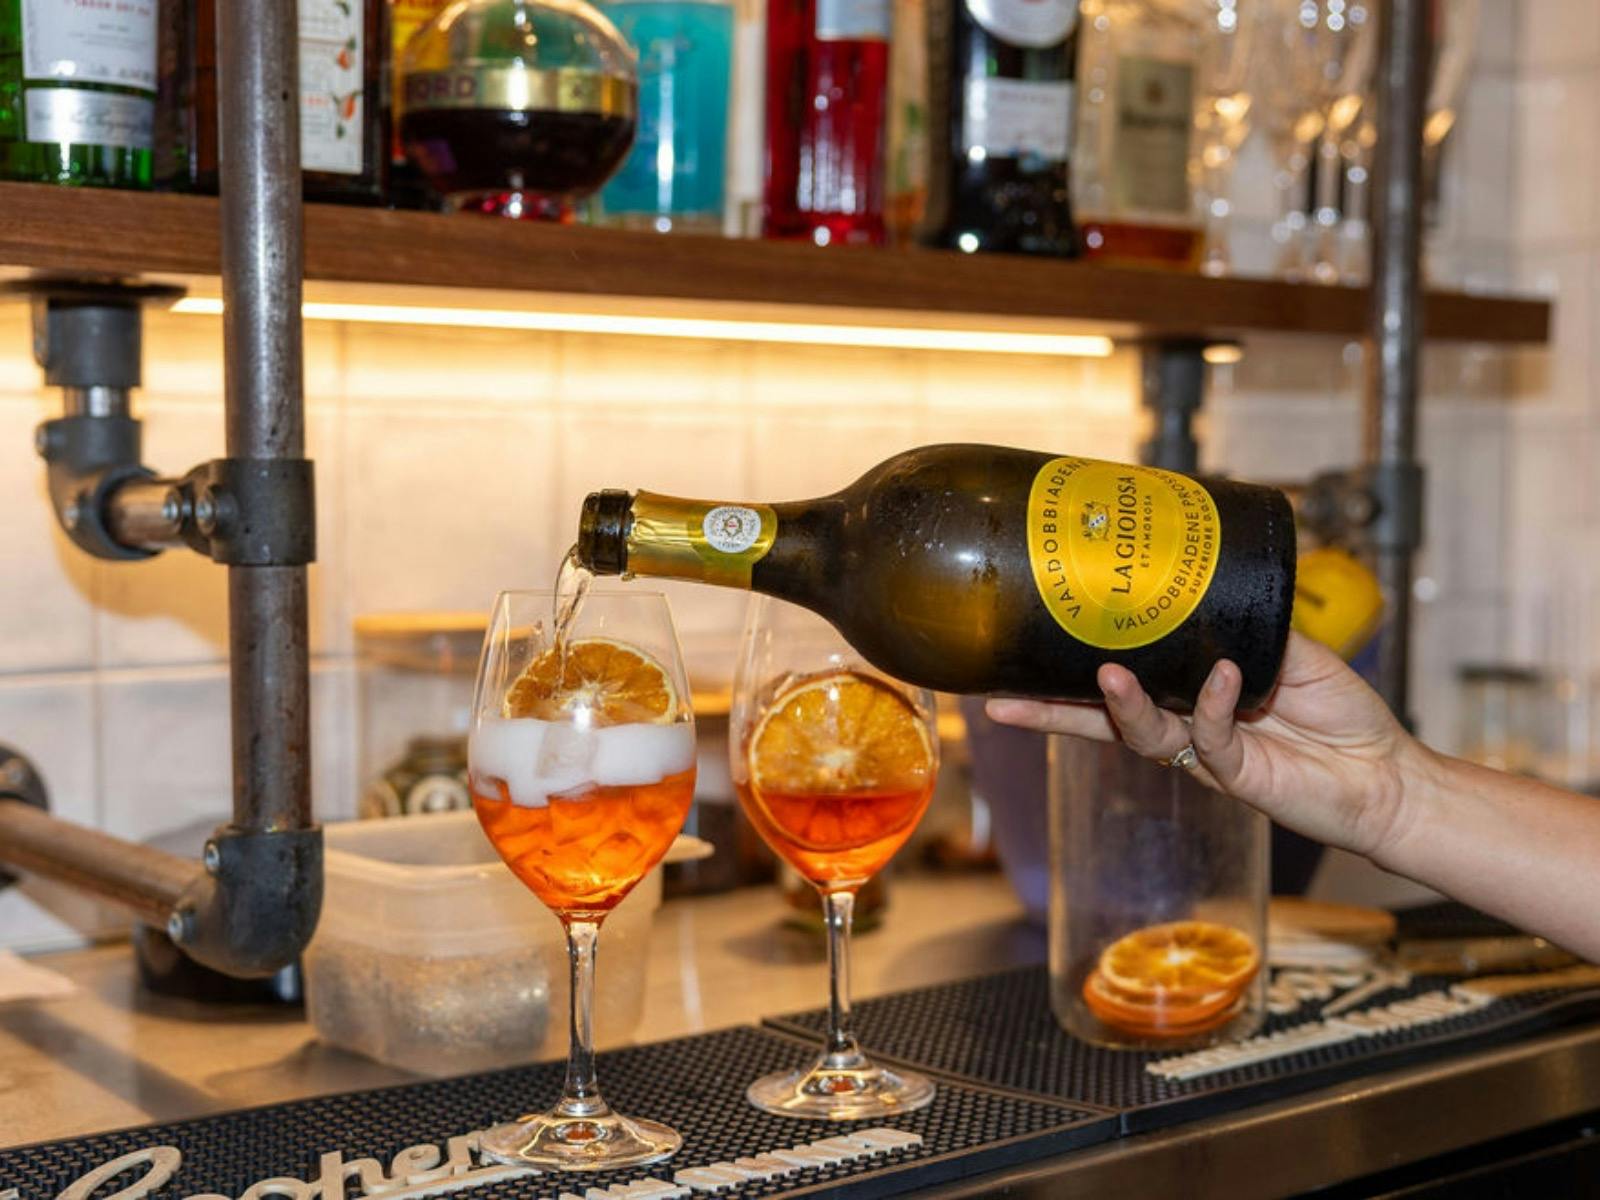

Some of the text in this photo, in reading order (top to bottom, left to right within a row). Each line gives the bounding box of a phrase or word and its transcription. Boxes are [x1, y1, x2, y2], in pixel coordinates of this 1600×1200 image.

[1111, 475, 1137, 595] LA GIOIOSA
[1143, 495, 1153, 550] AMOROSA
[1188, 527, 1214, 595] SUPERIORE
[1113, 511, 1201, 631] VALDOBBIADENE
